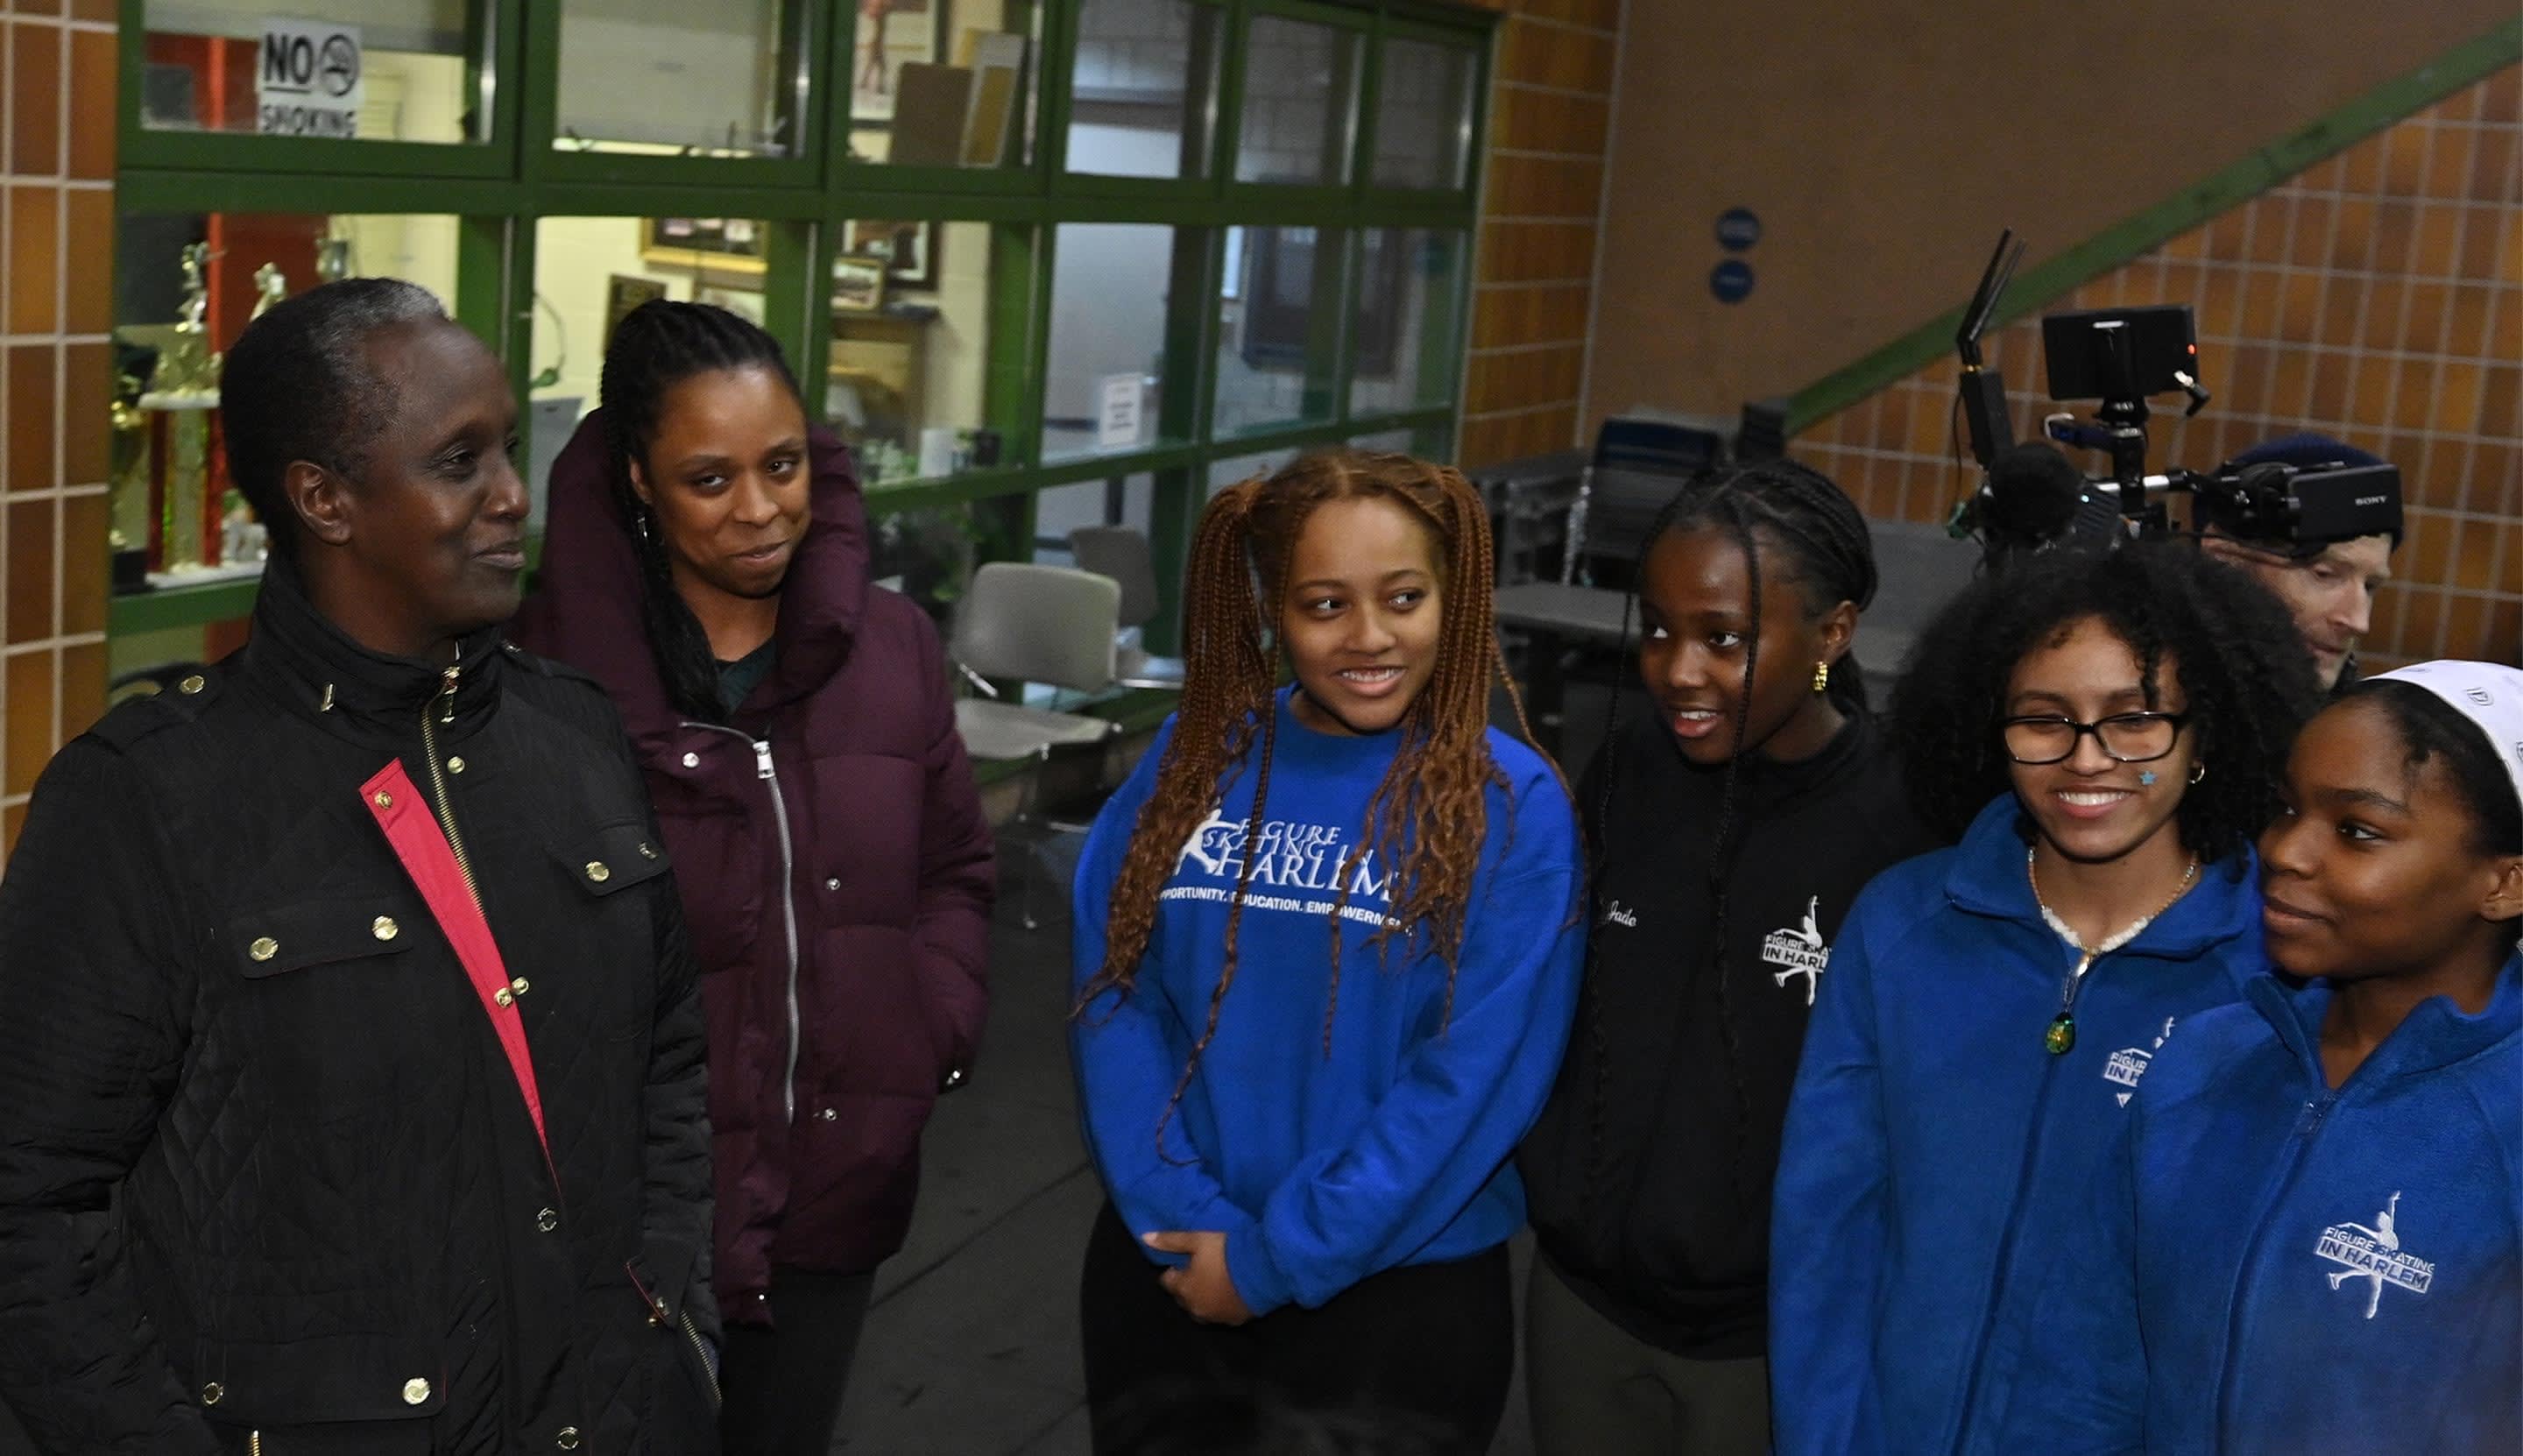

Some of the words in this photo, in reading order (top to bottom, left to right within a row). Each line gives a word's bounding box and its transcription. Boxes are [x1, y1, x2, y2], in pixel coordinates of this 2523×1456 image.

[265, 33, 314, 85] NO
[262, 105, 356, 138] SMOKING
[2355, 495, 2388, 507] SONY
[1238, 818, 1341, 845] FGURE
[1160, 886, 1227, 902] PORTUNITY.
[1765, 934, 1806, 951] FIGURE
[1765, 946, 1782, 960] IN
[2319, 1238, 2343, 1258] IN
[2343, 1242, 2429, 1290] HARLEM
[2324, 1226, 2377, 1252] FIGURE
[2375, 1244, 2435, 1275] SKATING
